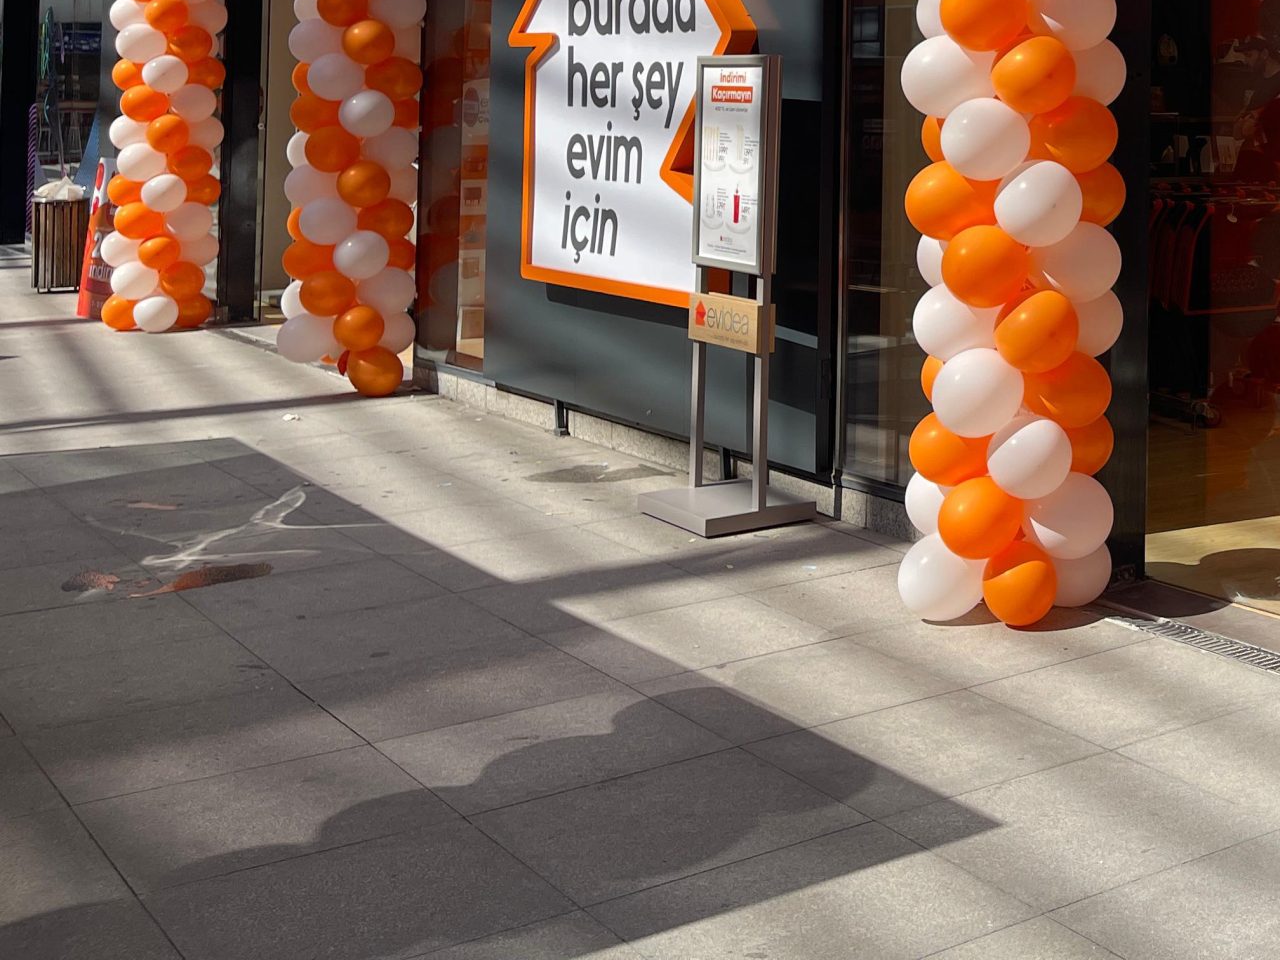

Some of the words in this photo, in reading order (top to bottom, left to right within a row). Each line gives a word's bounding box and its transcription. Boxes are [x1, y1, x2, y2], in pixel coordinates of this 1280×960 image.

[567, 45, 624, 108] her
[631, 61, 684, 129] şey
[566, 120, 643, 184] evim
[561, 190, 619, 263] için
[707, 306, 749, 336] evidea
